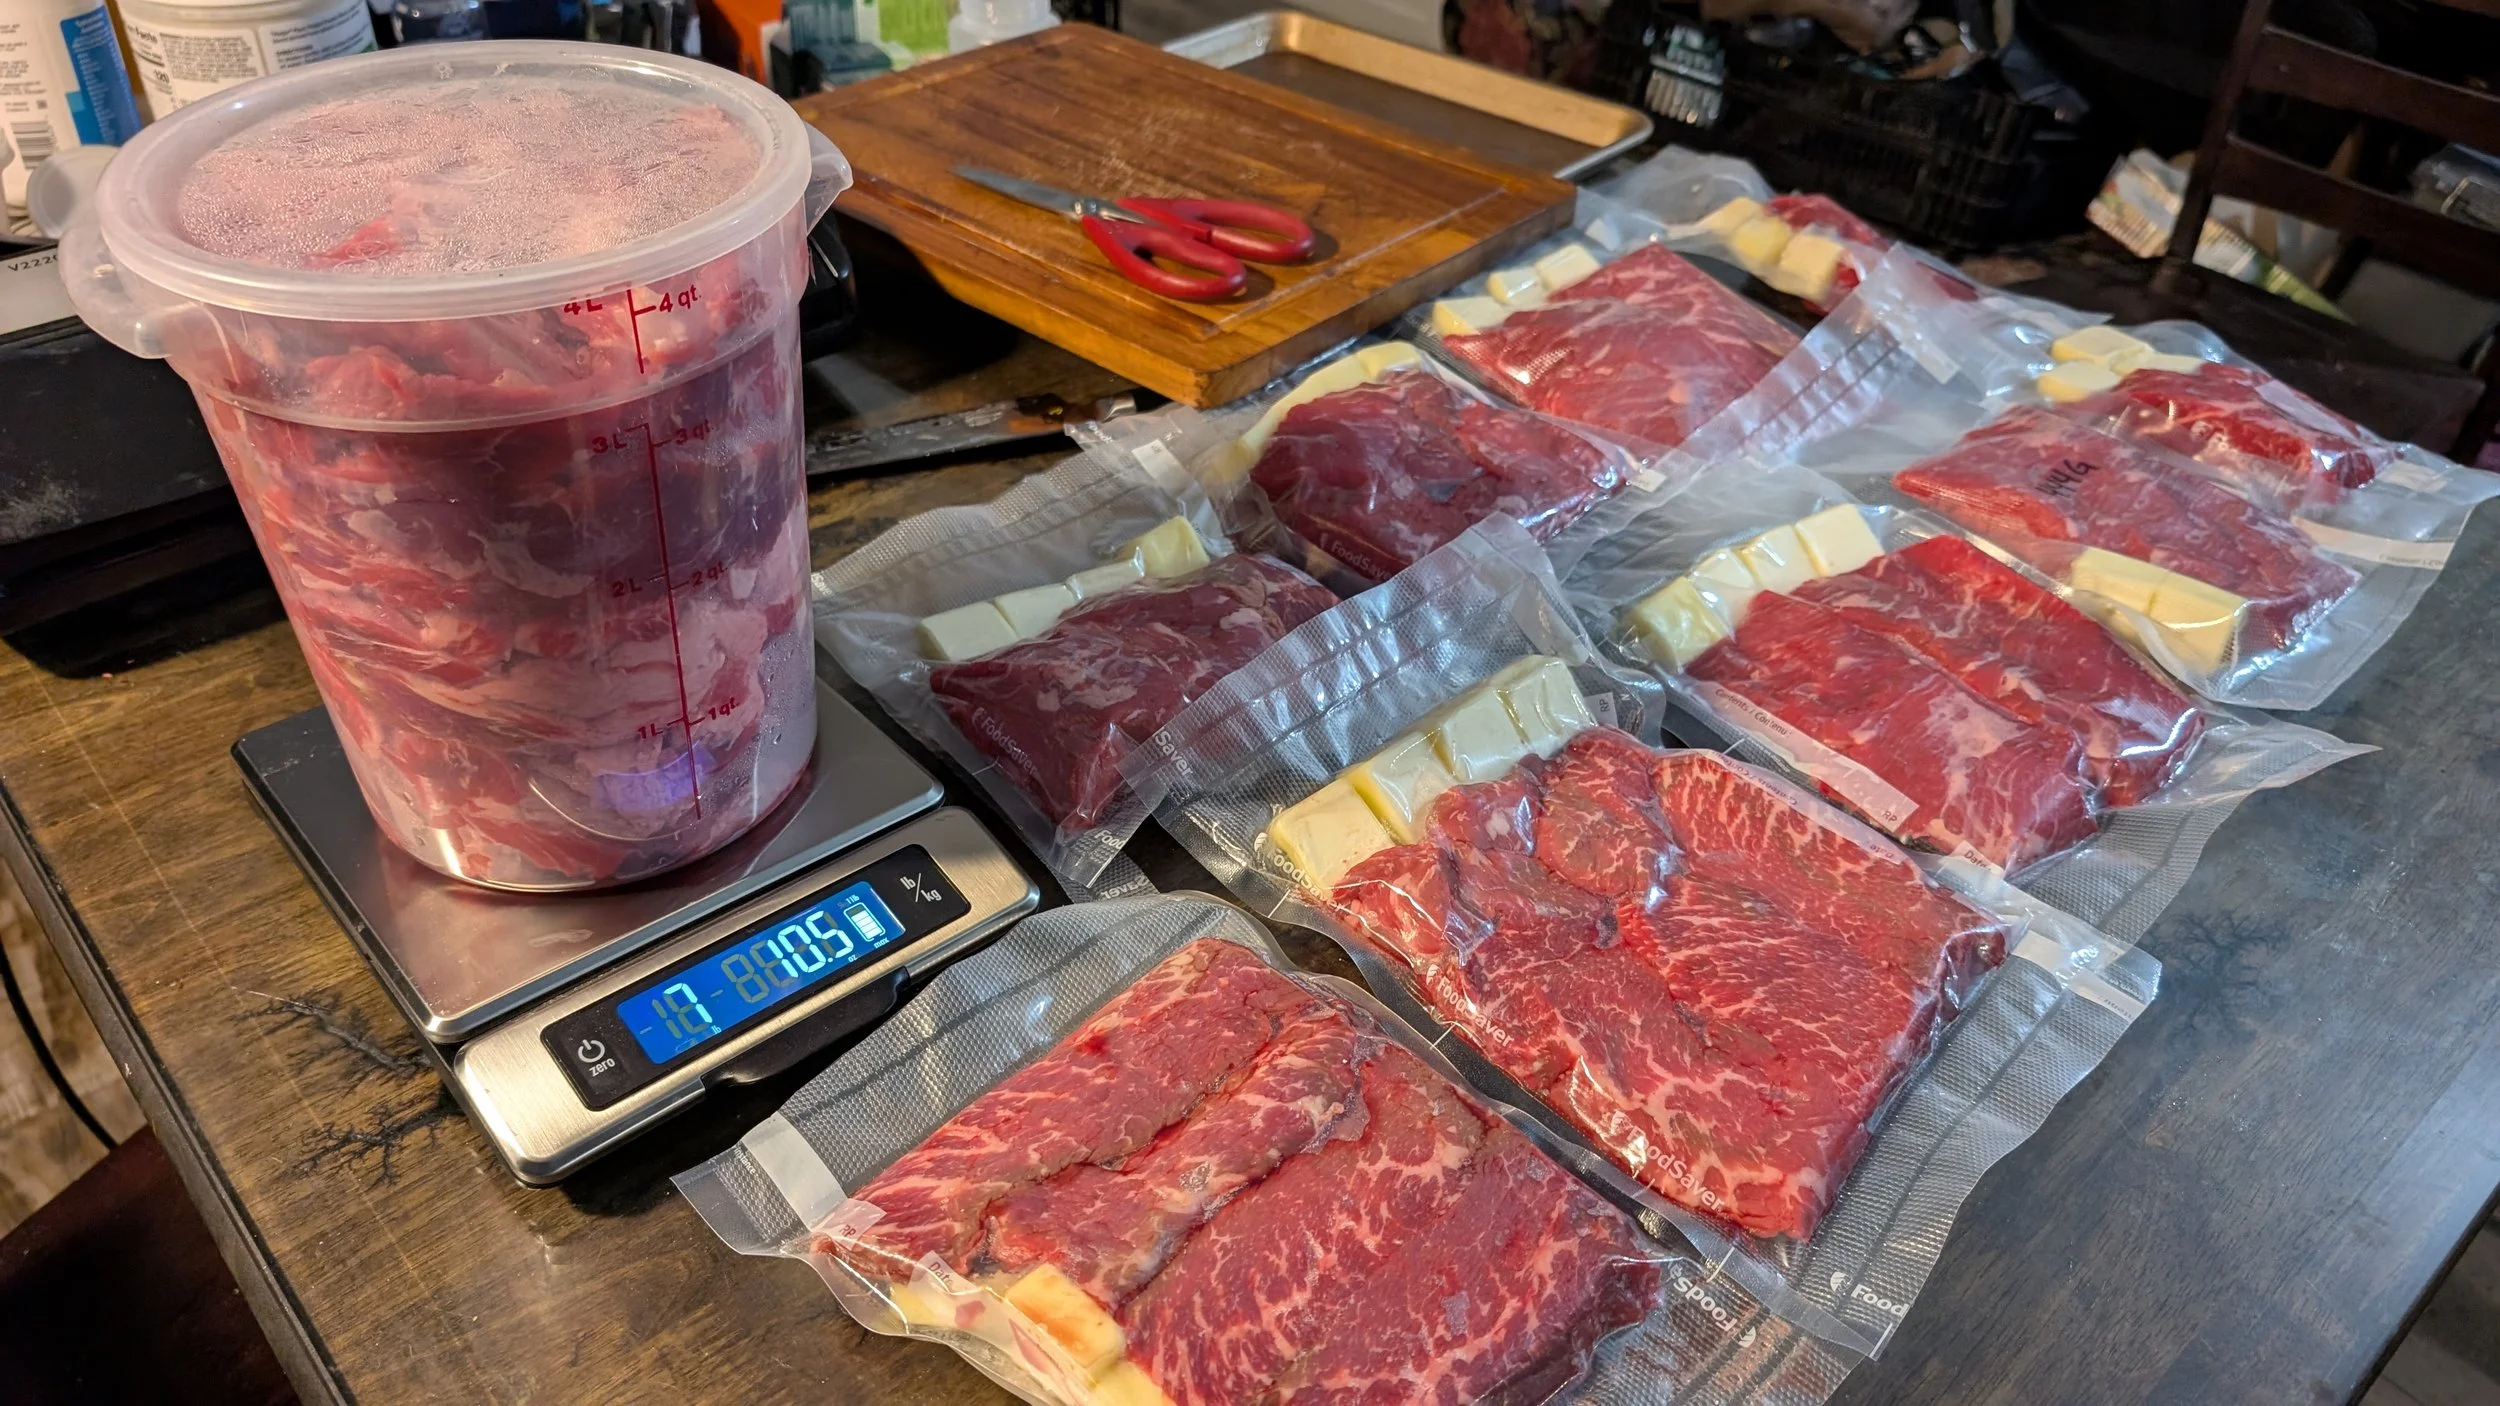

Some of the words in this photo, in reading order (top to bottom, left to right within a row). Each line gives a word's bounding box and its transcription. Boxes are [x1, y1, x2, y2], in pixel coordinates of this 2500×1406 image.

[1882, 810, 1898, 822] RP
[873, 937, 890, 949] max
[663, 983, 713, 1023] 7
[767, 910, 854, 978] 10.5
[589, 1057, 616, 1077] zero
[838, 1224, 857, 1237] RP
[1850, 1284, 1910, 1317] Food
